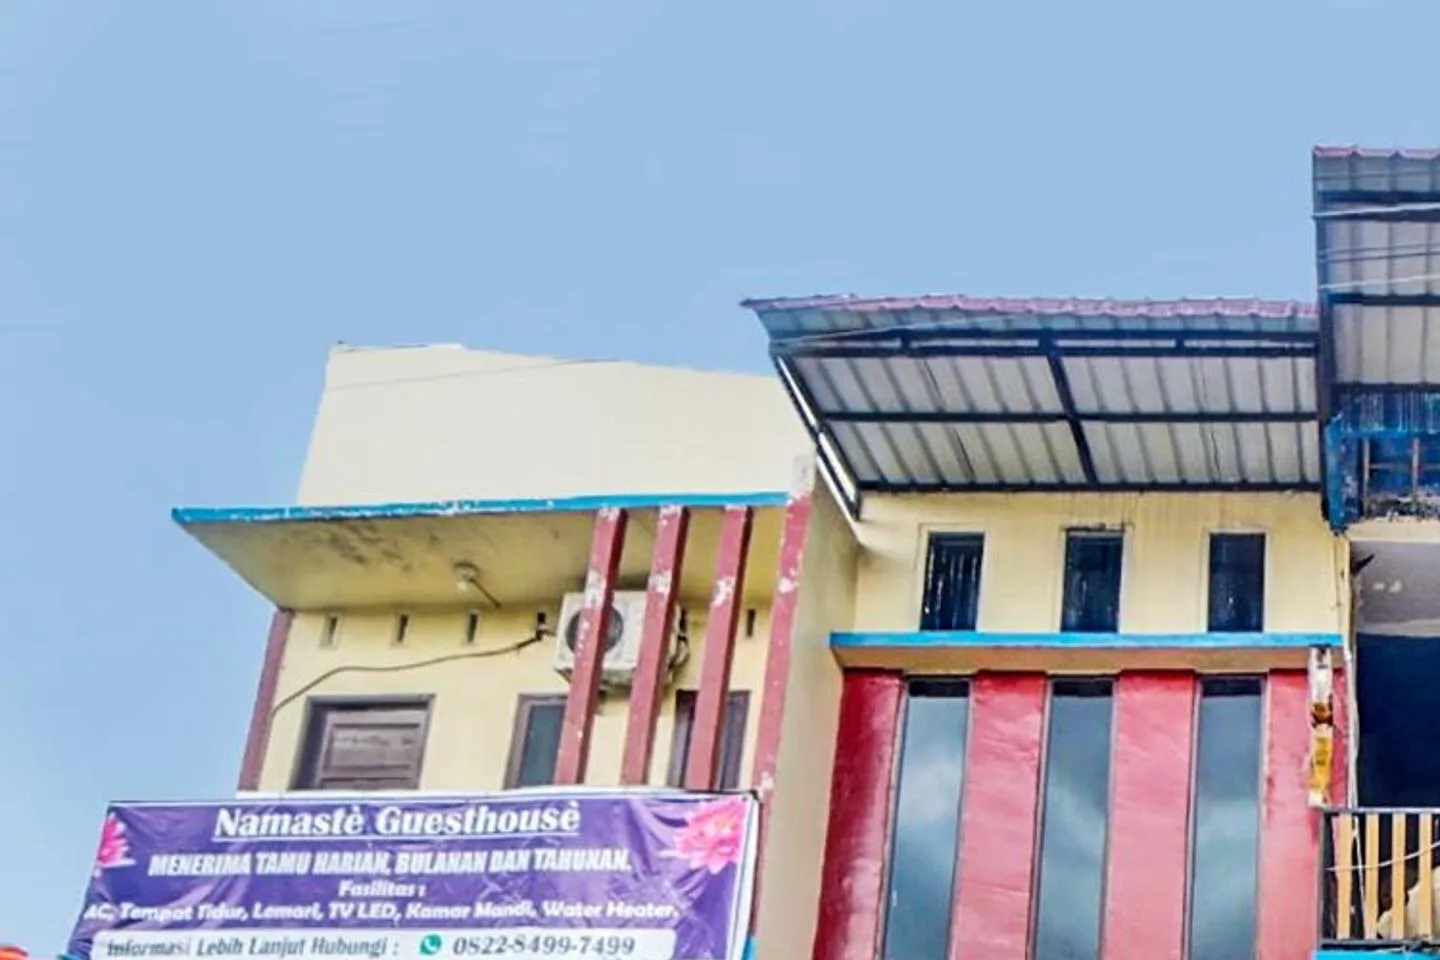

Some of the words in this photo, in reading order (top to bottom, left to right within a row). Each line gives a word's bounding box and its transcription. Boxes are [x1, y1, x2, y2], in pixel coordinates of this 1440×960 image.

[214, 805, 364, 837] Namastè
[148, 853, 250, 876] MENERIMA
[256, 851, 312, 875] TAMU
[394, 850, 486, 874] BULANAN
[489, 850, 530, 872] DAN
[338, 880, 415, 897] Fasilitas
[120, 902, 192, 922] Tempat
[329, 903, 354, 919] TV
[405, 902, 471, 919] Kamar
[541, 900, 601, 917] Water
[196, 936, 243, 957] Lebih
[249, 936, 306, 958] Lanjut
[311, 935, 388, 958] Hubungi
[452, 933, 637, 956] 0822-8499-7499
